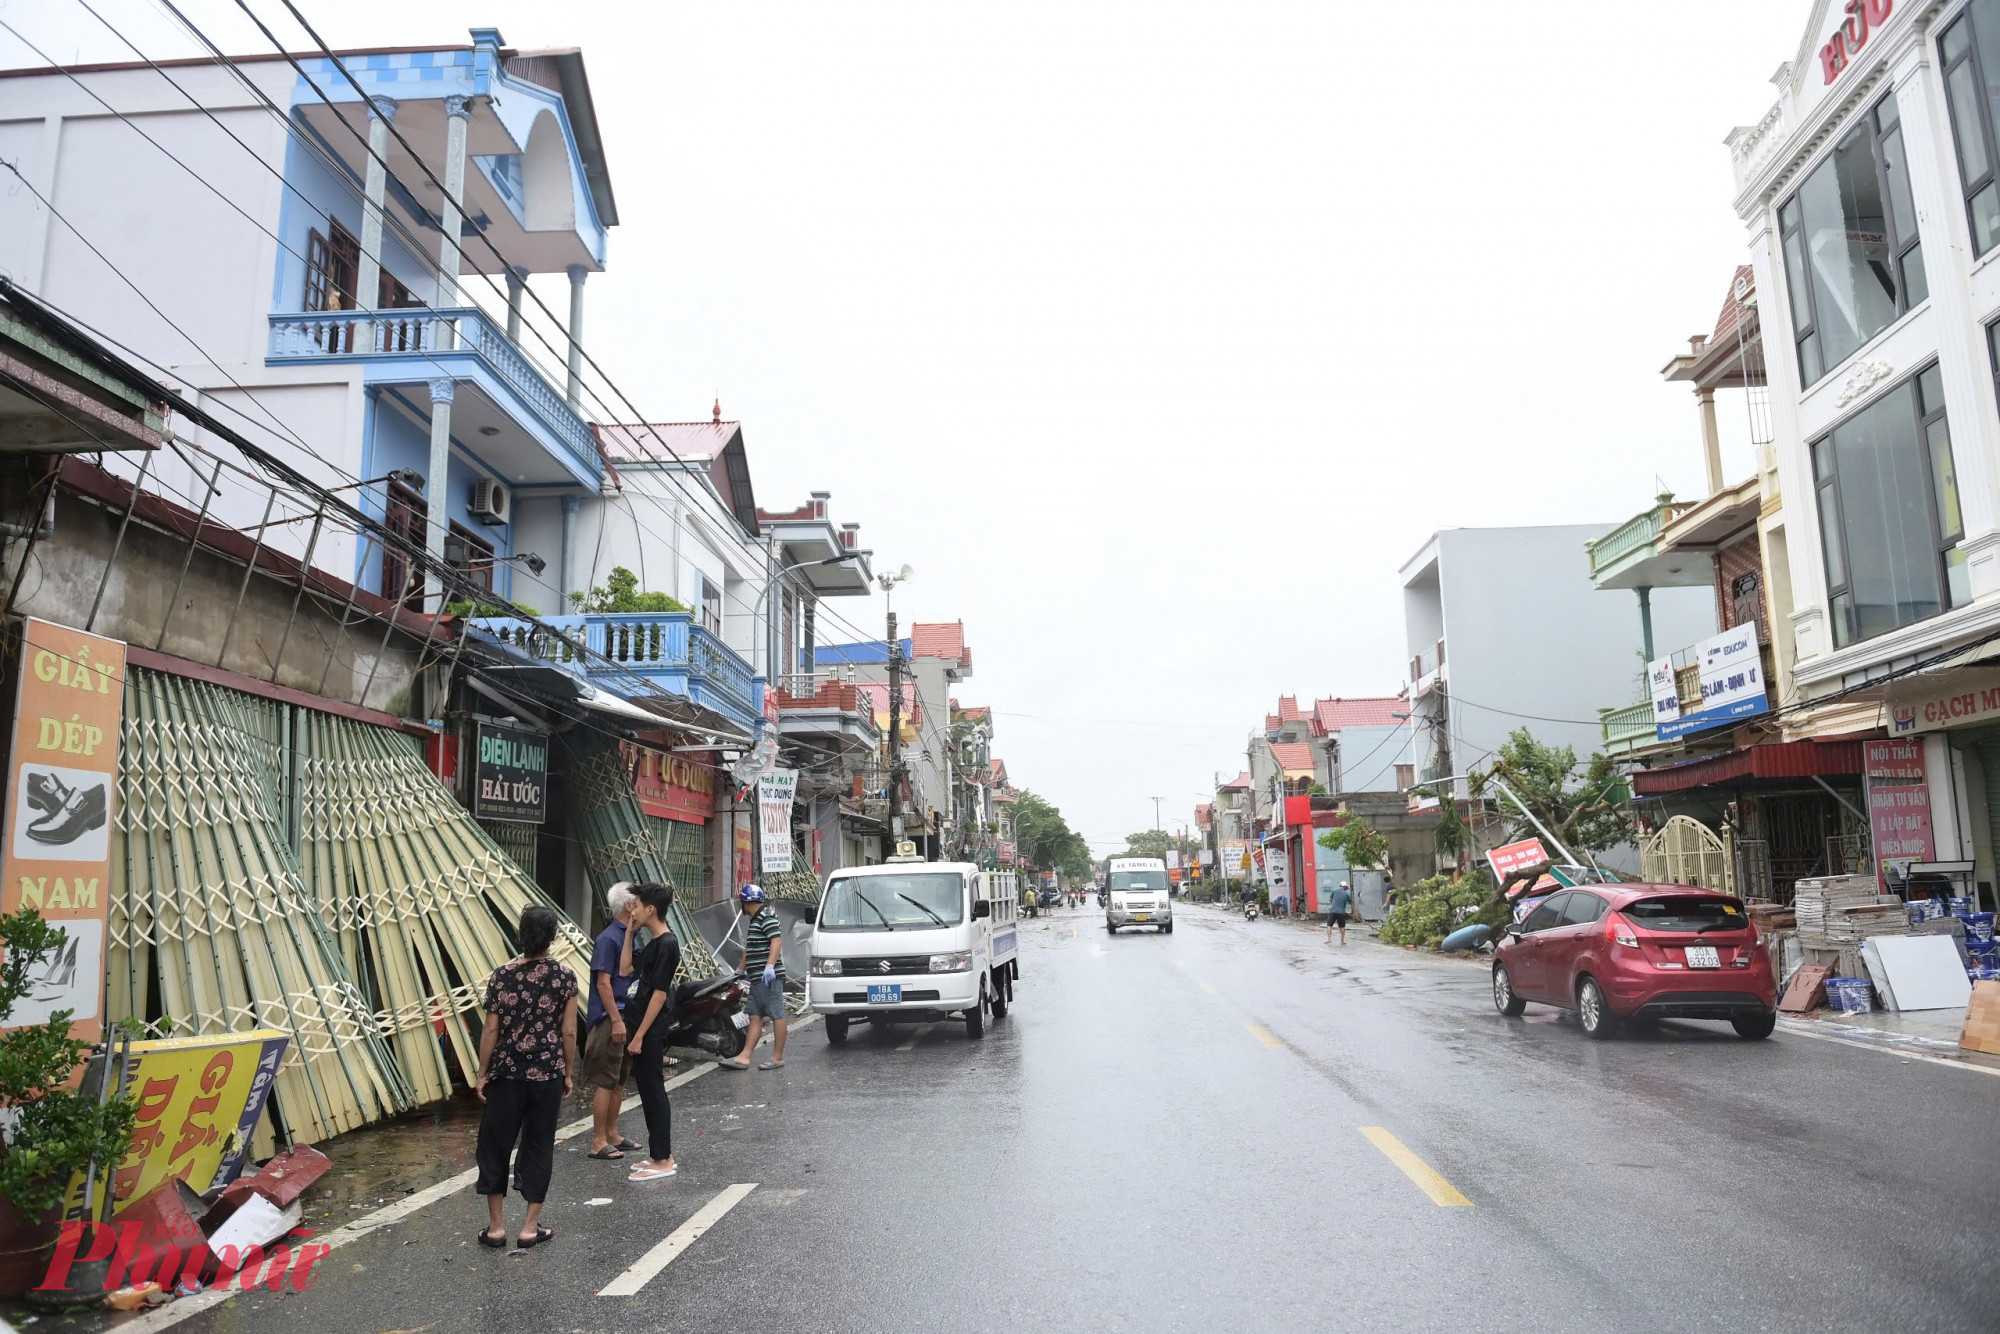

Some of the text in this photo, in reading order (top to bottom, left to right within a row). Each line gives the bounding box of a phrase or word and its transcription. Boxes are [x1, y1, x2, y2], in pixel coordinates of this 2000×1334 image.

[34, 644, 116, 694] GIẦY
[1924, 692, 1977, 726] GẠCH
[37, 713, 103, 756] DÉP
[481, 732, 545, 774] ĐIỆN LẠNH
[1870, 745, 1889, 762] NỘI
[481, 773, 510, 802] HẢI
[512, 776, 540, 805] ƯỚC
[1872, 786, 1926, 810] NHẬN TƯ VẤN
[1880, 812, 1921, 832] & LẮP ĐẶT
[1881, 836, 1926, 857] ĐIỆN NƯỚC
[18, 876, 99, 909] NAM
[1694, 946, 1711, 957] 30A
[871, 993, 898, 1002] 009.69
[877, 985, 892, 993] 18A
